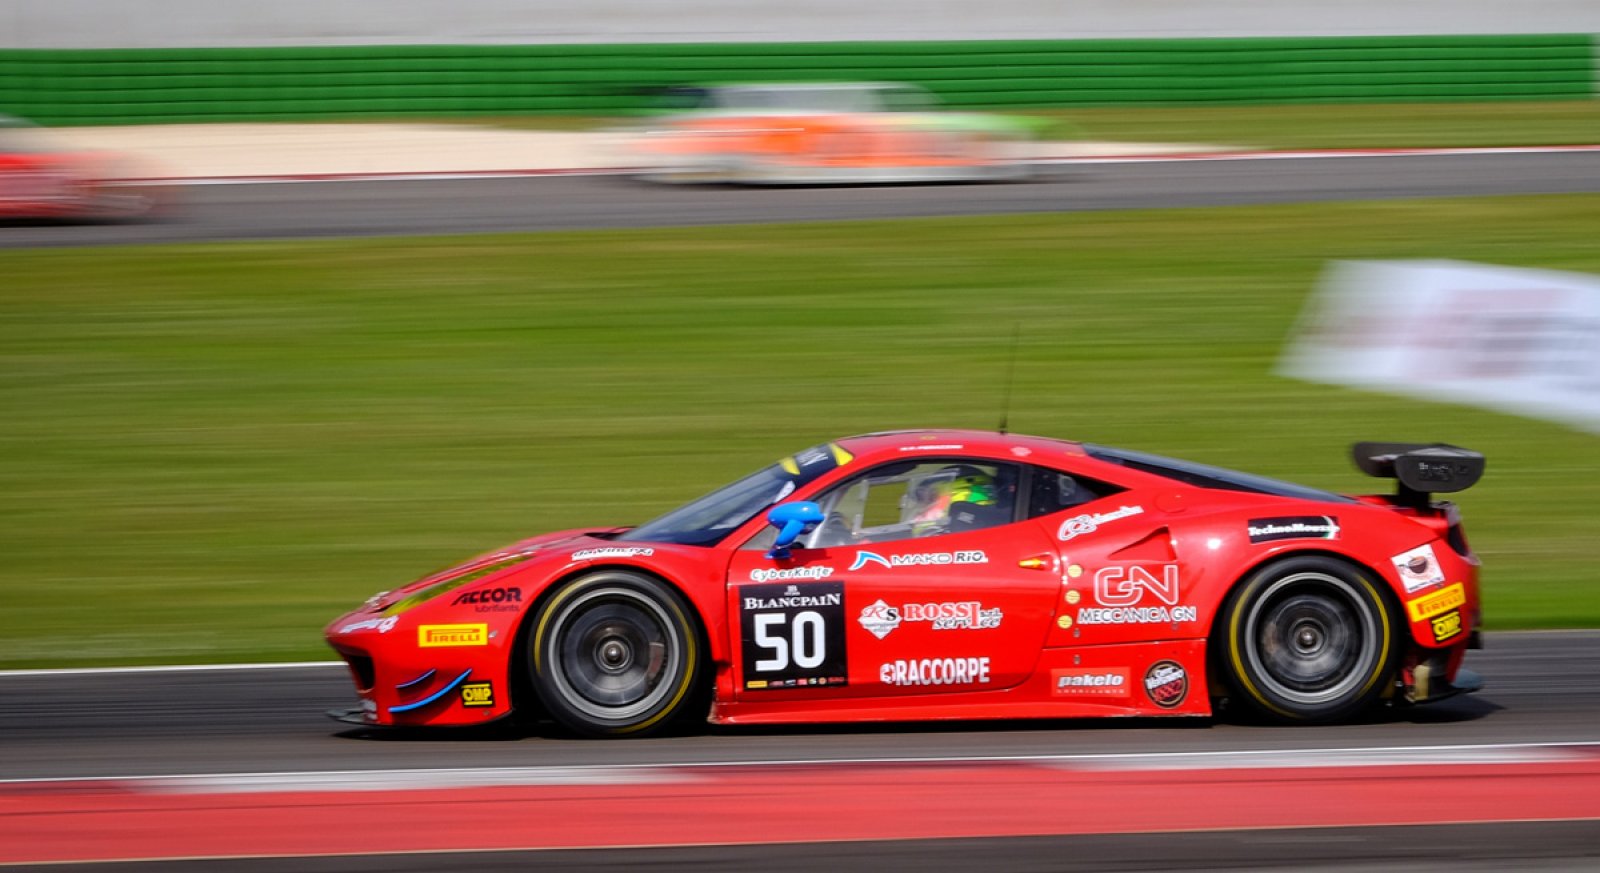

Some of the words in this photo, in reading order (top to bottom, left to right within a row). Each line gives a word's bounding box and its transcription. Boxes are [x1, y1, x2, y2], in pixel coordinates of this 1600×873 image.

[892, 553, 951, 565] MAKO
[751, 566, 832, 582] CyberKnife
[450, 586, 522, 607] ACCOR
[743, 592, 842, 610] BLANCPAIN
[903, 602, 981, 627] ROSSI
[1078, 607, 1170, 623] MECCANICA
[1171, 606, 1197, 621] GN
[426, 628, 481, 643] PIRELLI
[753, 611, 826, 672] 50
[894, 657, 991, 686] RACCORPE
[1057, 673, 1125, 688] pakelo
[462, 687, 492, 702] OMP
